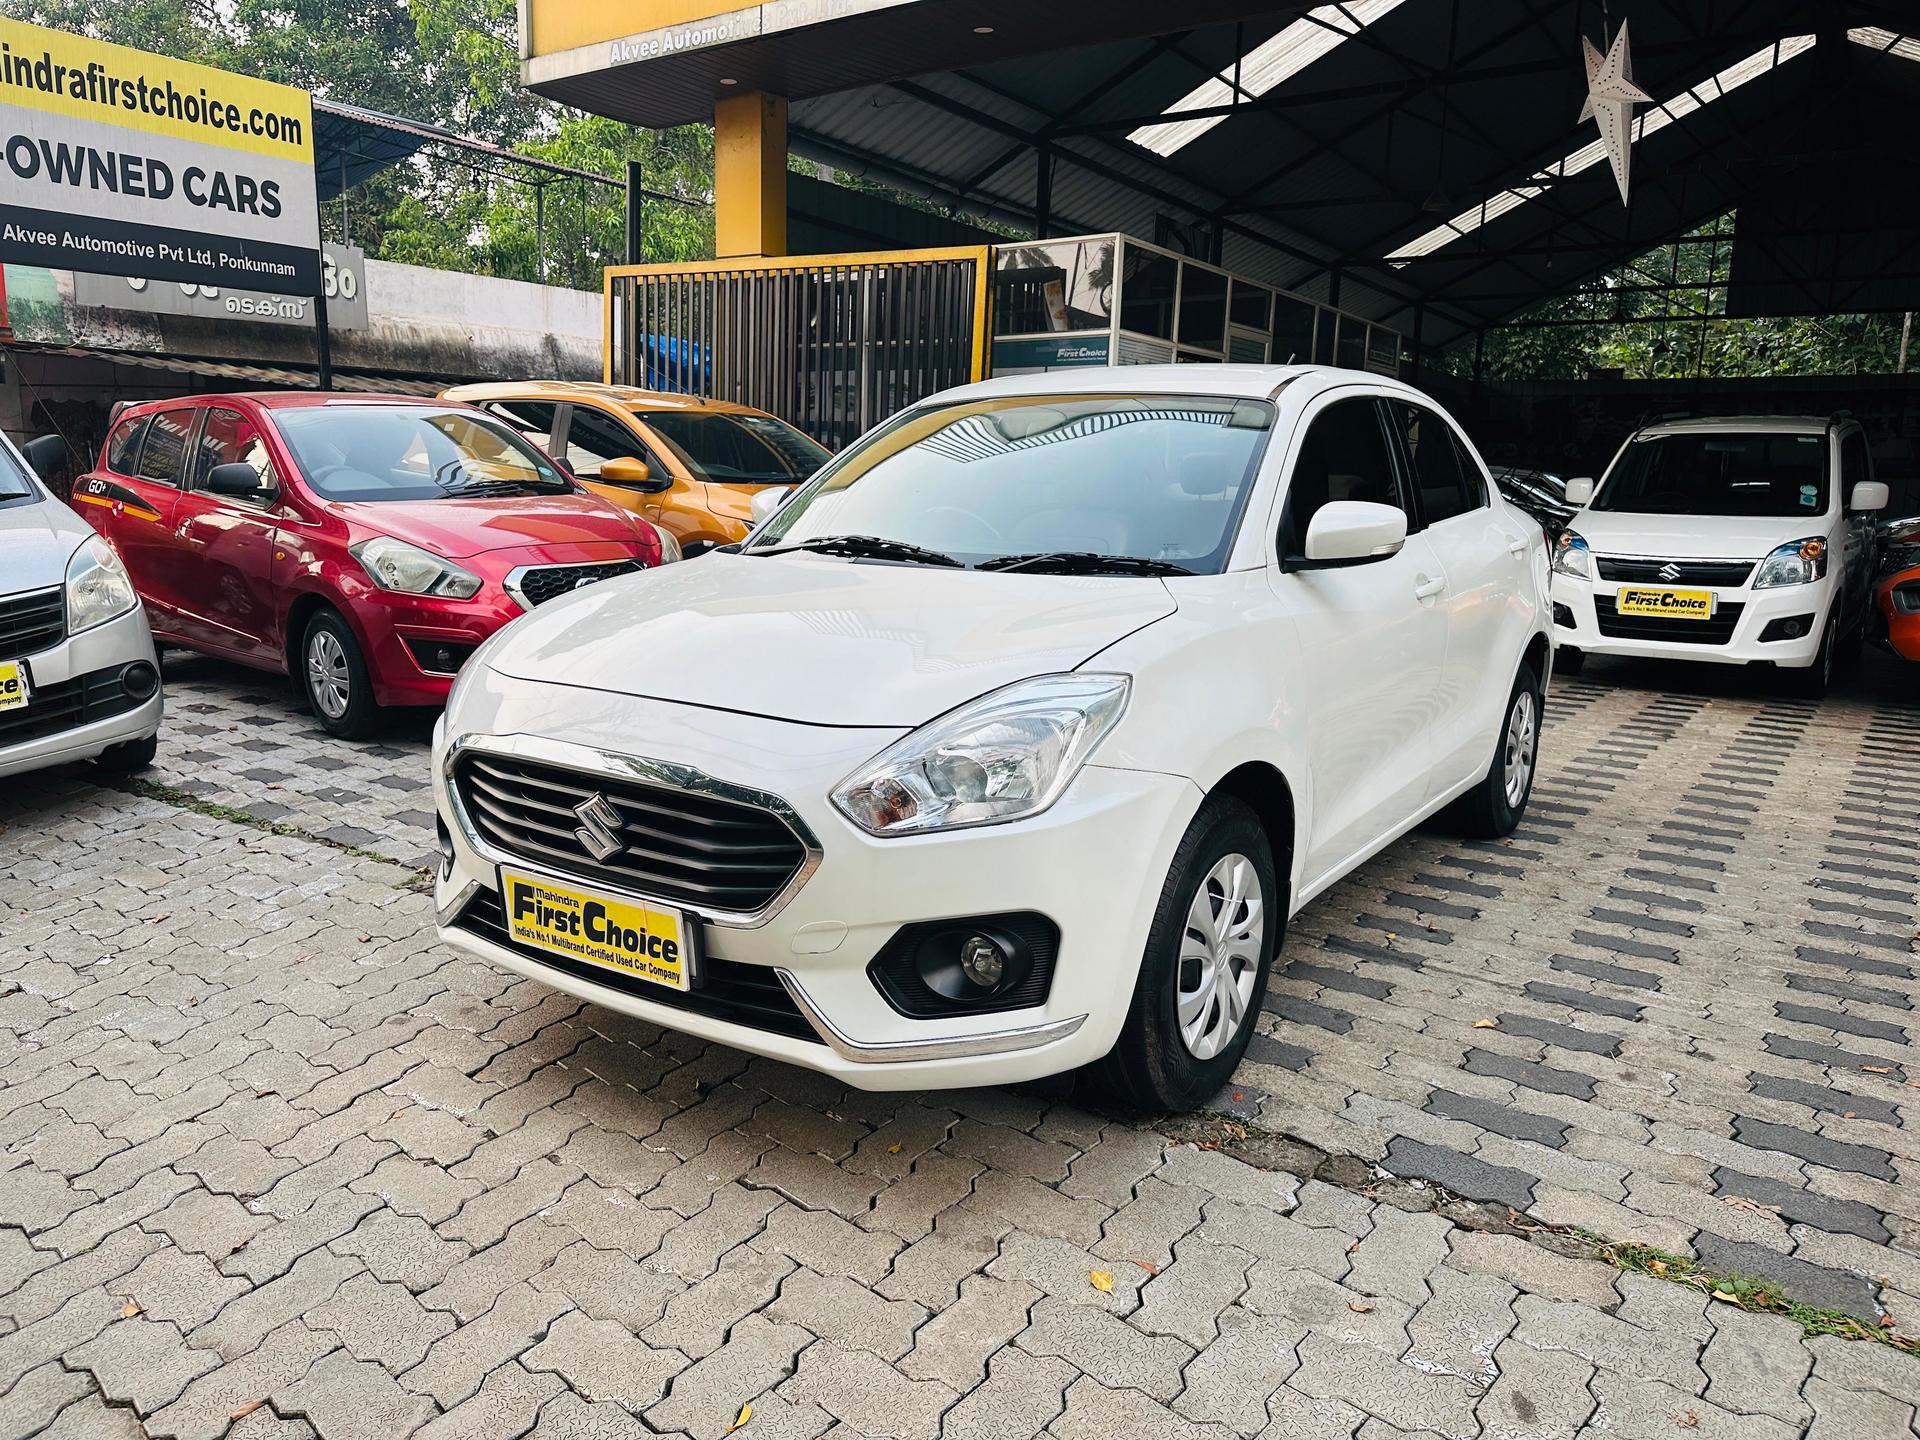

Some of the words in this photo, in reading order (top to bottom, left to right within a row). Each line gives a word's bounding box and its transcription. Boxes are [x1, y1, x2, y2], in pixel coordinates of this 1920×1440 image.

[610, 39, 659, 63] Akvee
[0, 43, 302, 145] indrafirstchoice.com
[182, 166, 282, 218] CARS
[3, 223, 57, 246] Akvee
[62, 231, 155, 258] Automotive
[159, 244, 184, 262] Pvt
[187, 249, 216, 269] Ltd,
[219, 253, 296, 277] Ponkunnam
[1624, 591, 1660, 606] First
[1660, 593, 1707, 609] Choice
[513, 882, 581, 936] First
[583, 901, 678, 963] Choice
[514, 924, 535, 940] India's
[536, 931, 550, 944] No.1
[551, 935, 585, 954] Multibrand
[585, 945, 615, 963] Certified
[615, 953, 633, 968] Used
[634, 960, 647, 972] Car
[648, 963, 681, 985] Company
